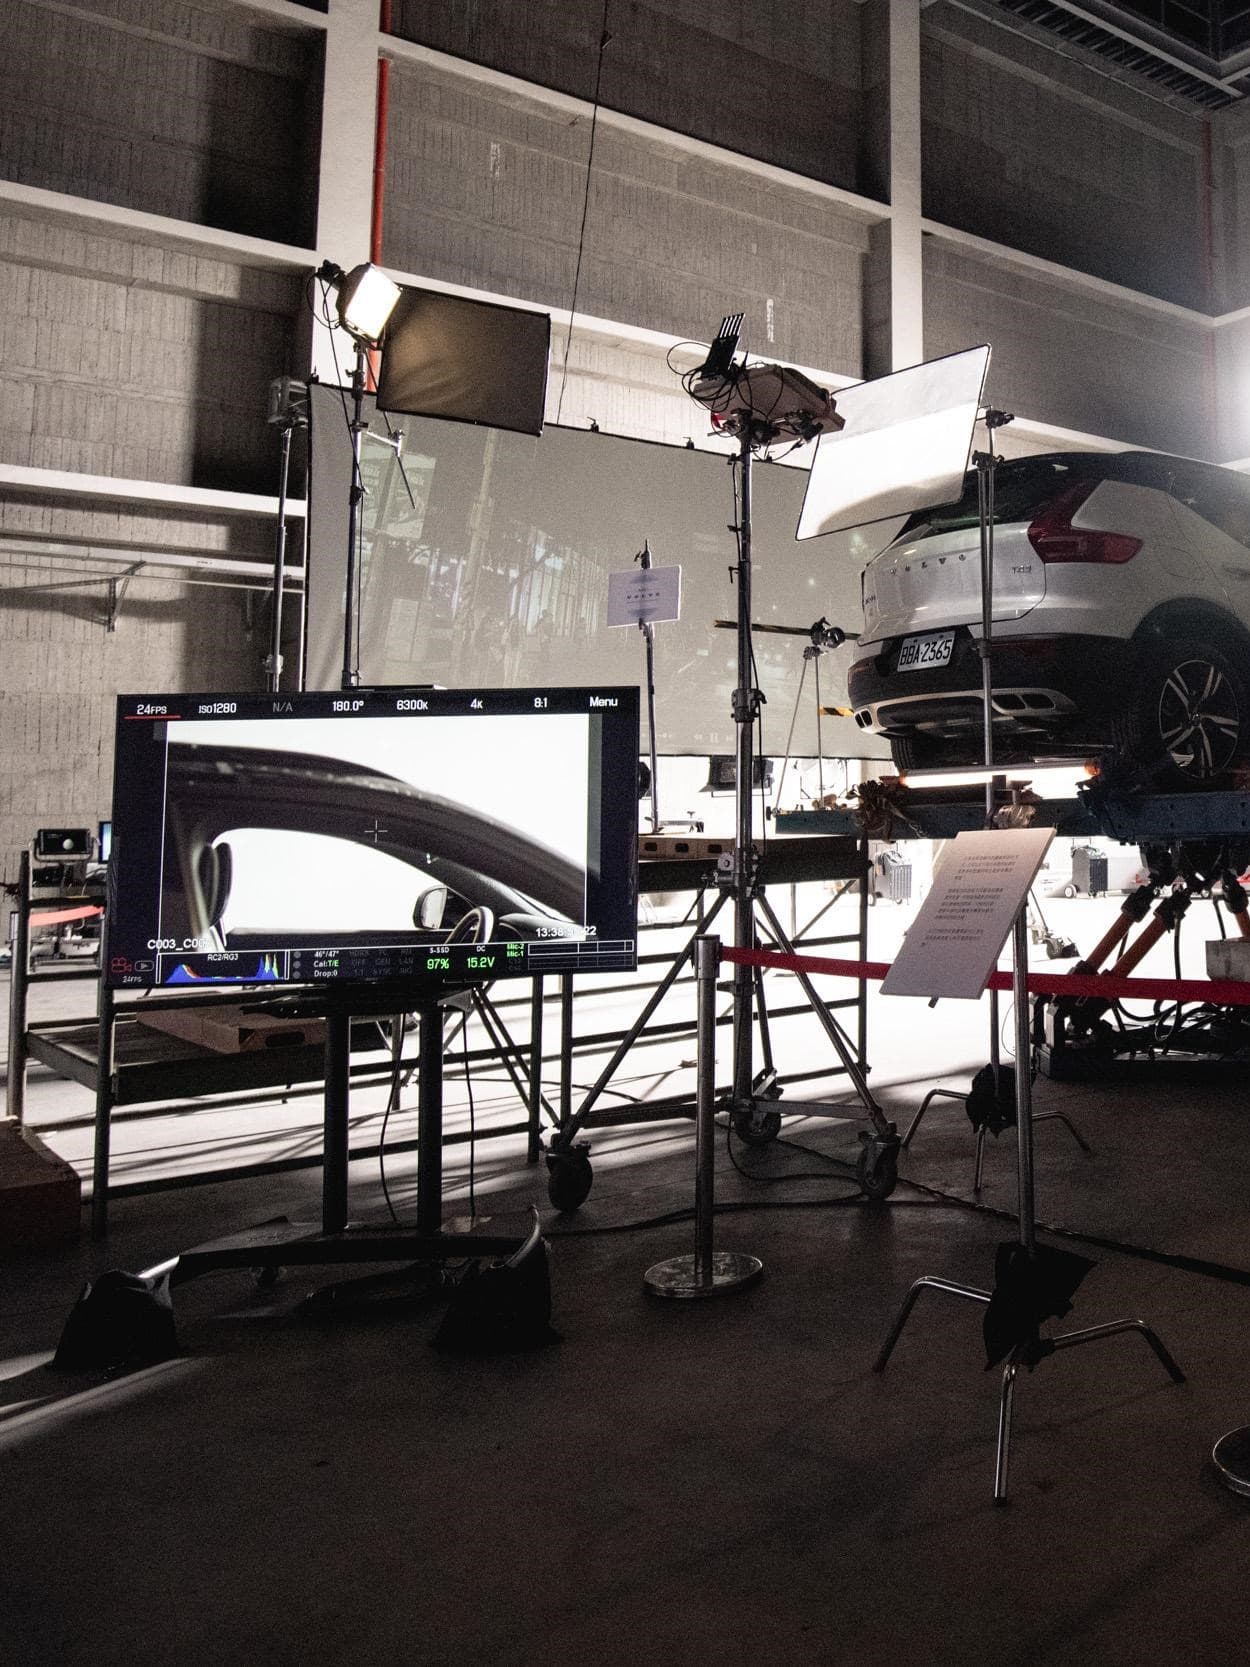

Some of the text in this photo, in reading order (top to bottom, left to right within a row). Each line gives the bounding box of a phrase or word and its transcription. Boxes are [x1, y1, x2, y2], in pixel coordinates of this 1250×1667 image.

[272, 702, 293, 712] N/A
[589, 696, 618, 707] Menu
[426, 958, 450, 970] 97%
[466, 956, 495, 968] 15.2V
